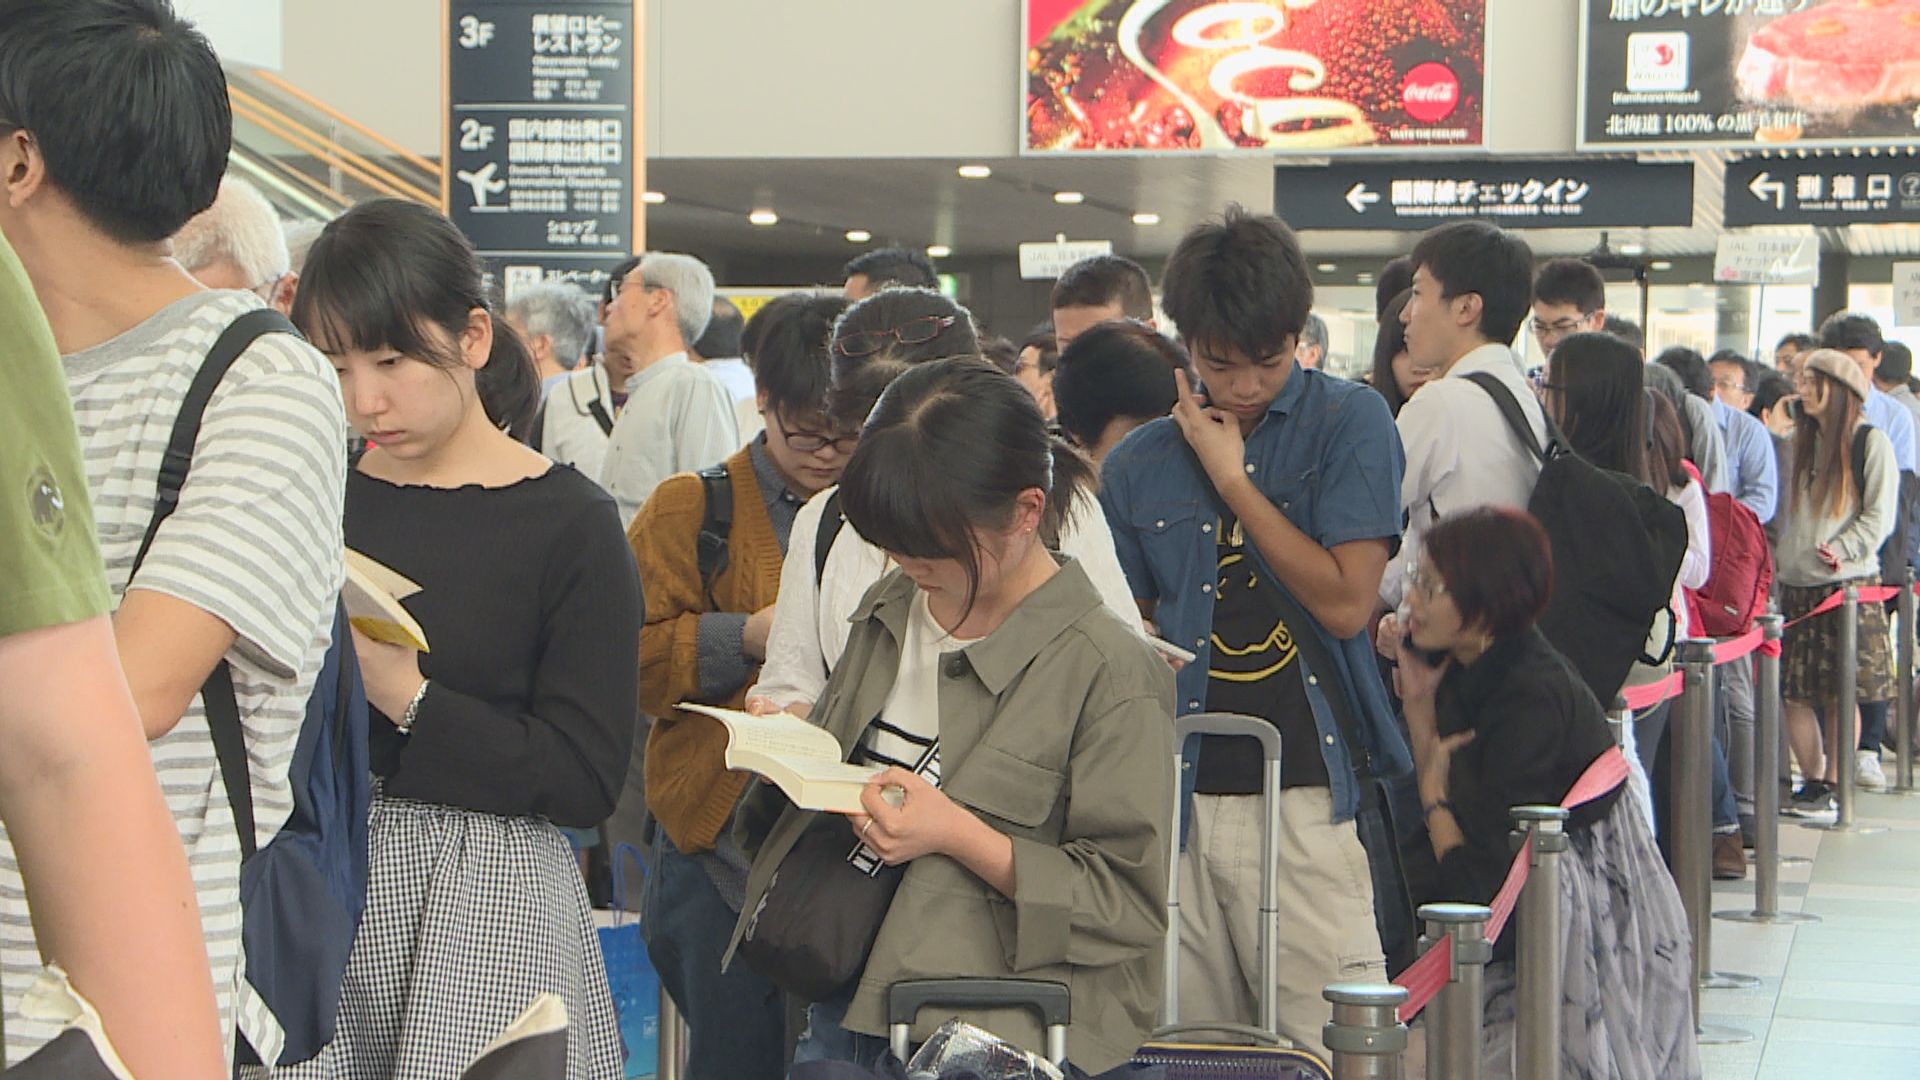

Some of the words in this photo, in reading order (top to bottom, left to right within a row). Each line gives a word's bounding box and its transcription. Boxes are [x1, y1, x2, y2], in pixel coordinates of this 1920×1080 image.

[459, 16, 495, 48] 3F
[533, 34, 622, 53] レストラン
[1403, 82, 1455, 102] Coca-Cola
[459, 118, 496, 150] 2F
[509, 119, 622, 141] 国内線出発口
[1605, 113, 1661, 135] 北海道
[1665, 114, 1715, 133] 100%
[509, 142, 622, 164] 国際線出発口
[1391, 178, 1590, 205] 国際線チェックイン
[1797, 174, 1892, 199] 到着口
[547, 219, 597, 234] ショップ
